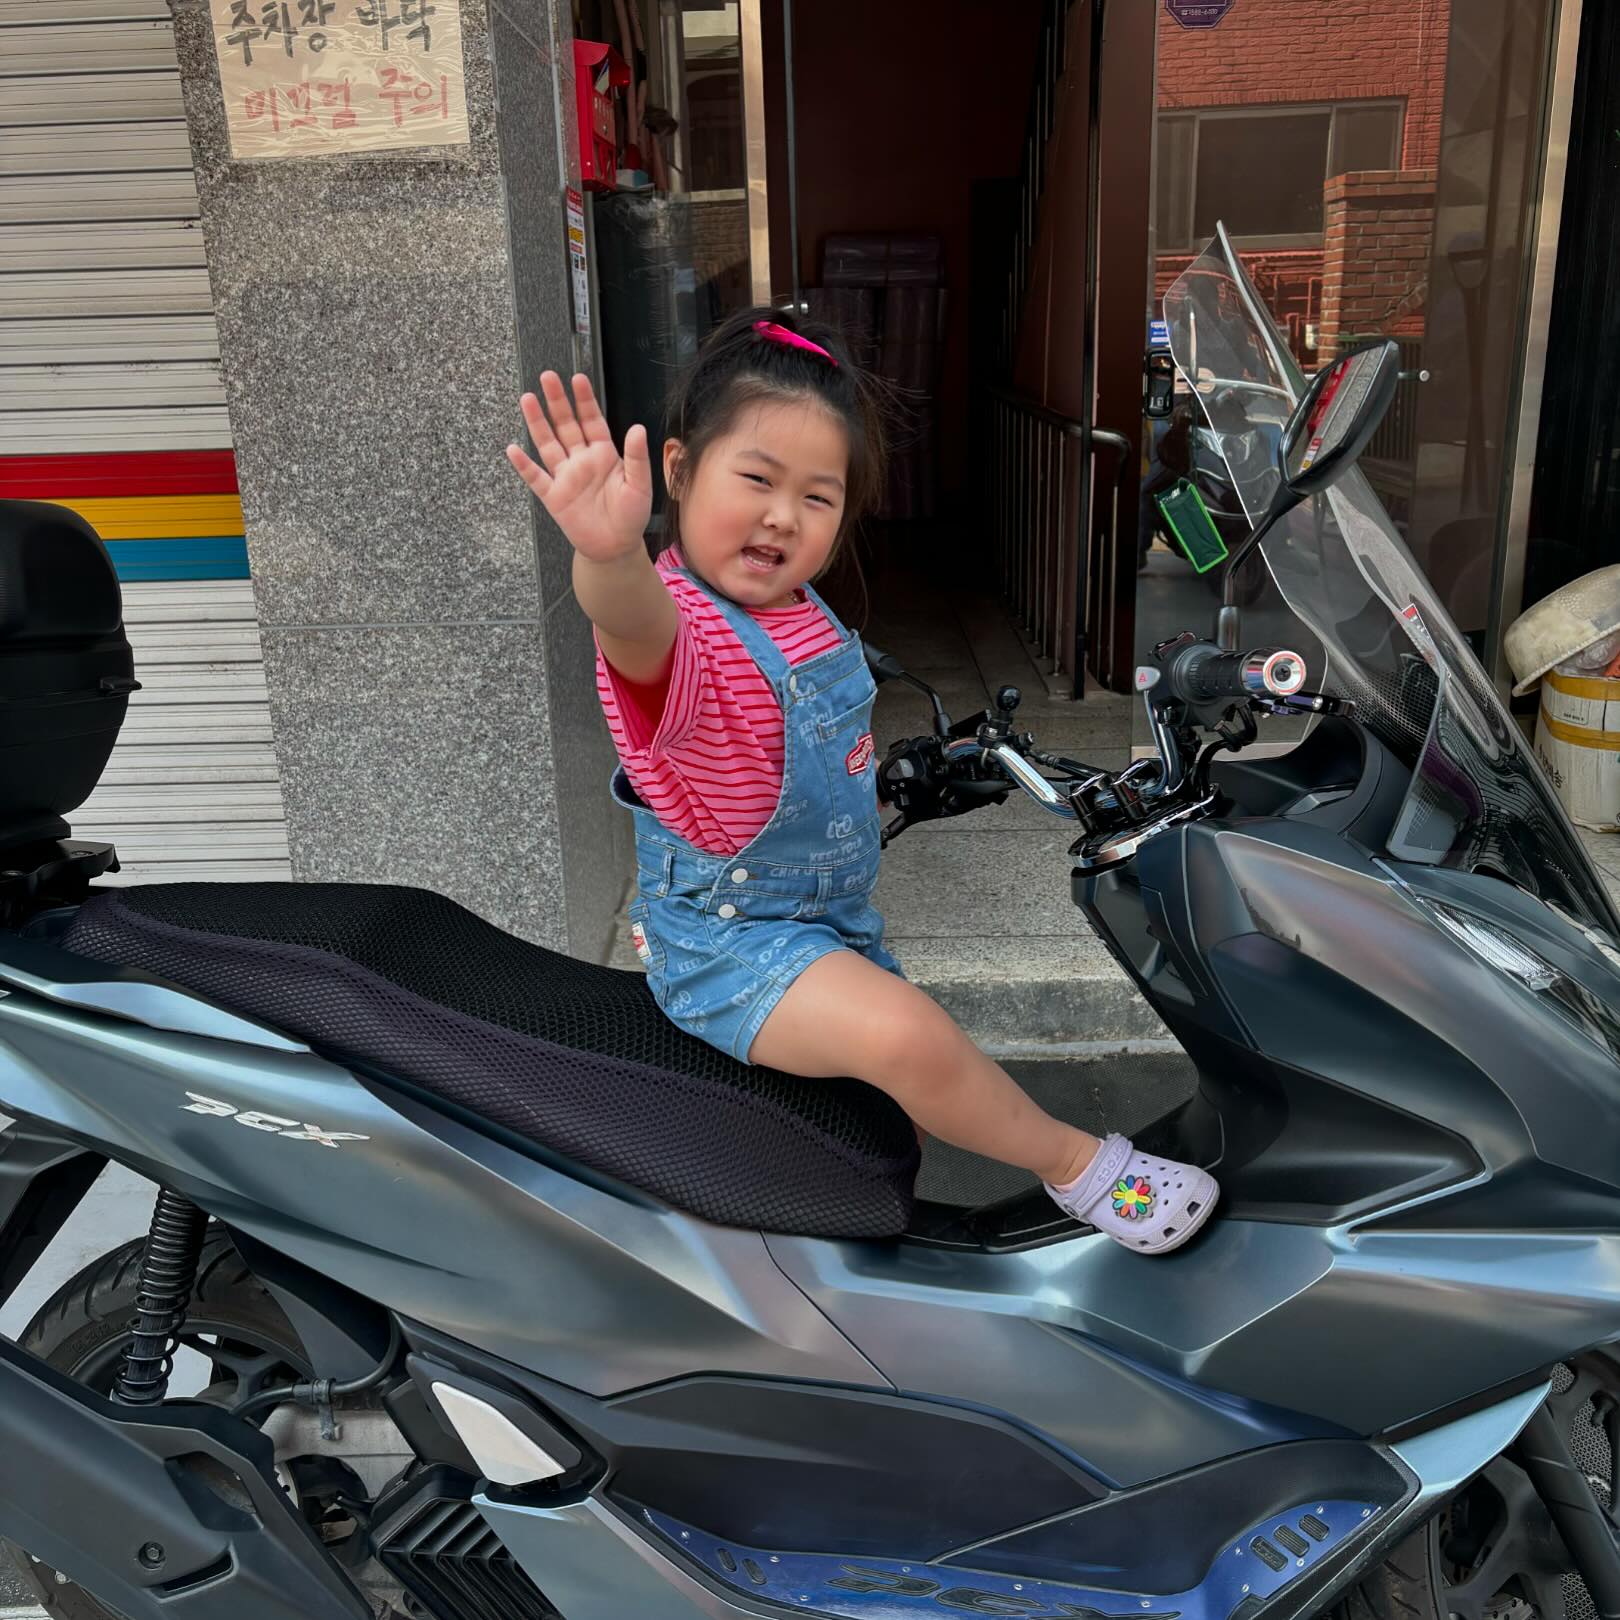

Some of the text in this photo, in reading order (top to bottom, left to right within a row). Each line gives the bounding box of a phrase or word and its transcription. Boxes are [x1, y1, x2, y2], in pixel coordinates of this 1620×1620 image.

[225, 0, 436, 66] 주차장 바닥
[379, 68, 449, 128] 주의
[178, 1091, 371, 1148] PCX
